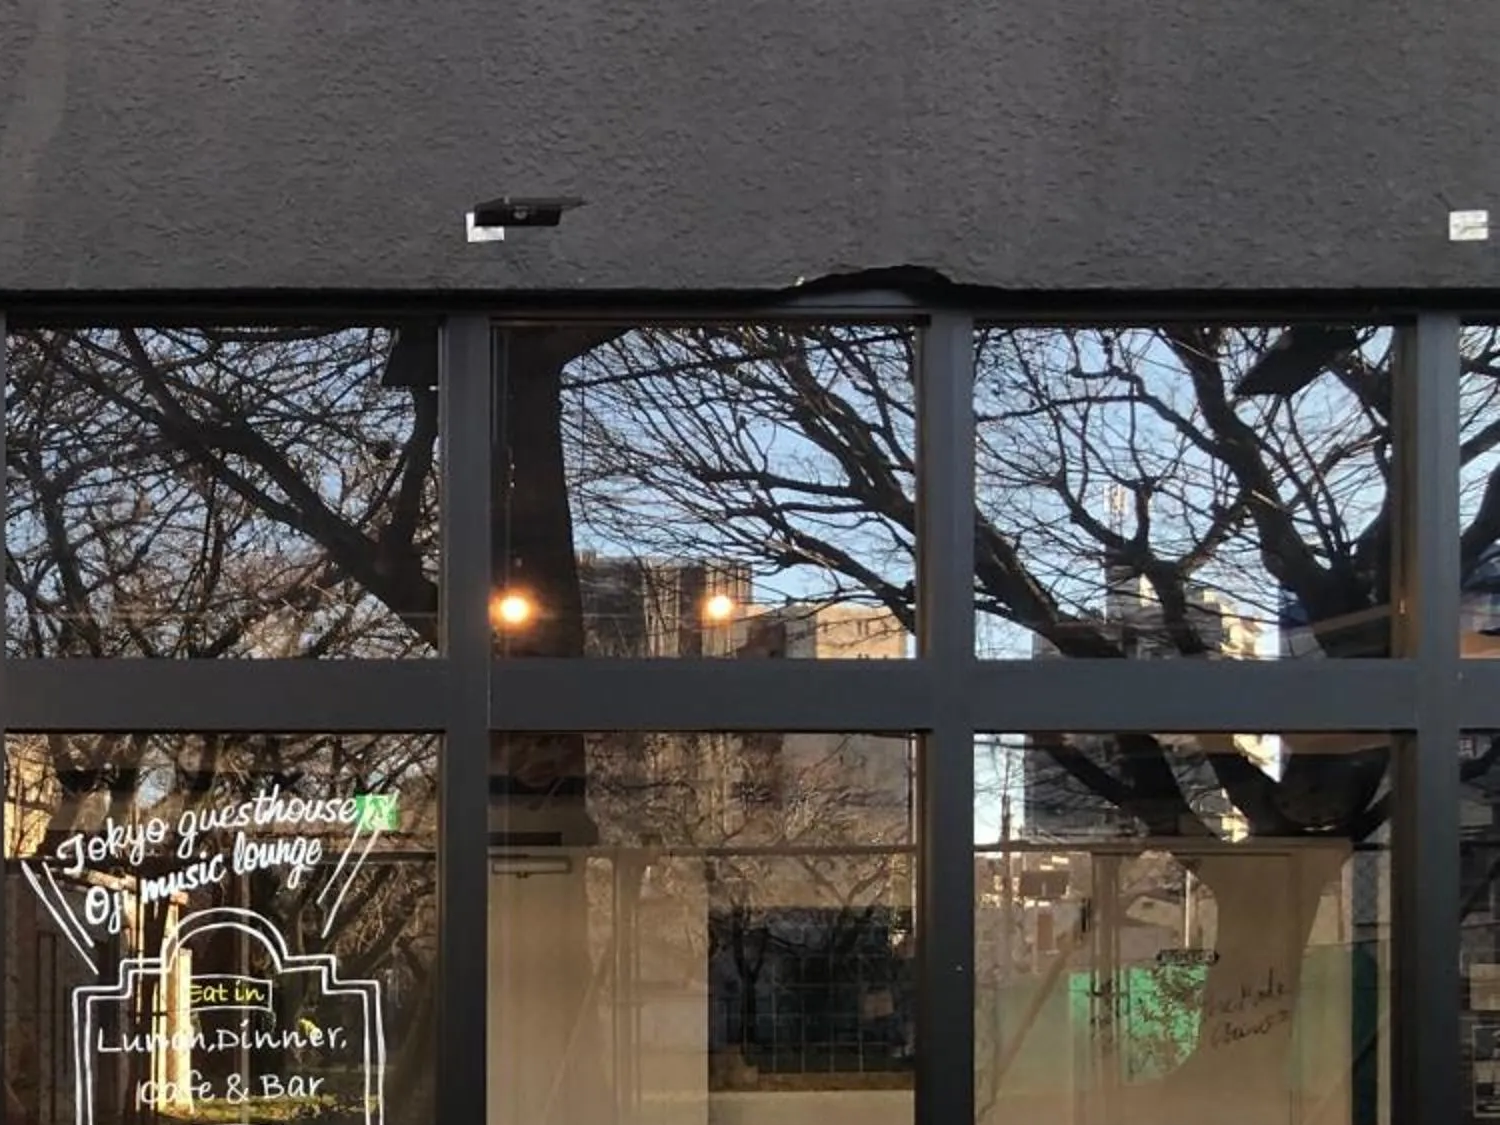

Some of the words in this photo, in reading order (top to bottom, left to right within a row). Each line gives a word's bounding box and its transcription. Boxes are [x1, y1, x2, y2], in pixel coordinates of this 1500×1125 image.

[57, 817, 165, 873] Tokyo
[178, 784, 358, 859] guesthouse
[141, 851, 226, 904] music
[233, 832, 322, 888] lounge
[189, 983, 229, 1003] Eat
[235, 979, 265, 1002] in
[226, 1073, 249, 1105] &
[260, 1073, 326, 1099] Bar
